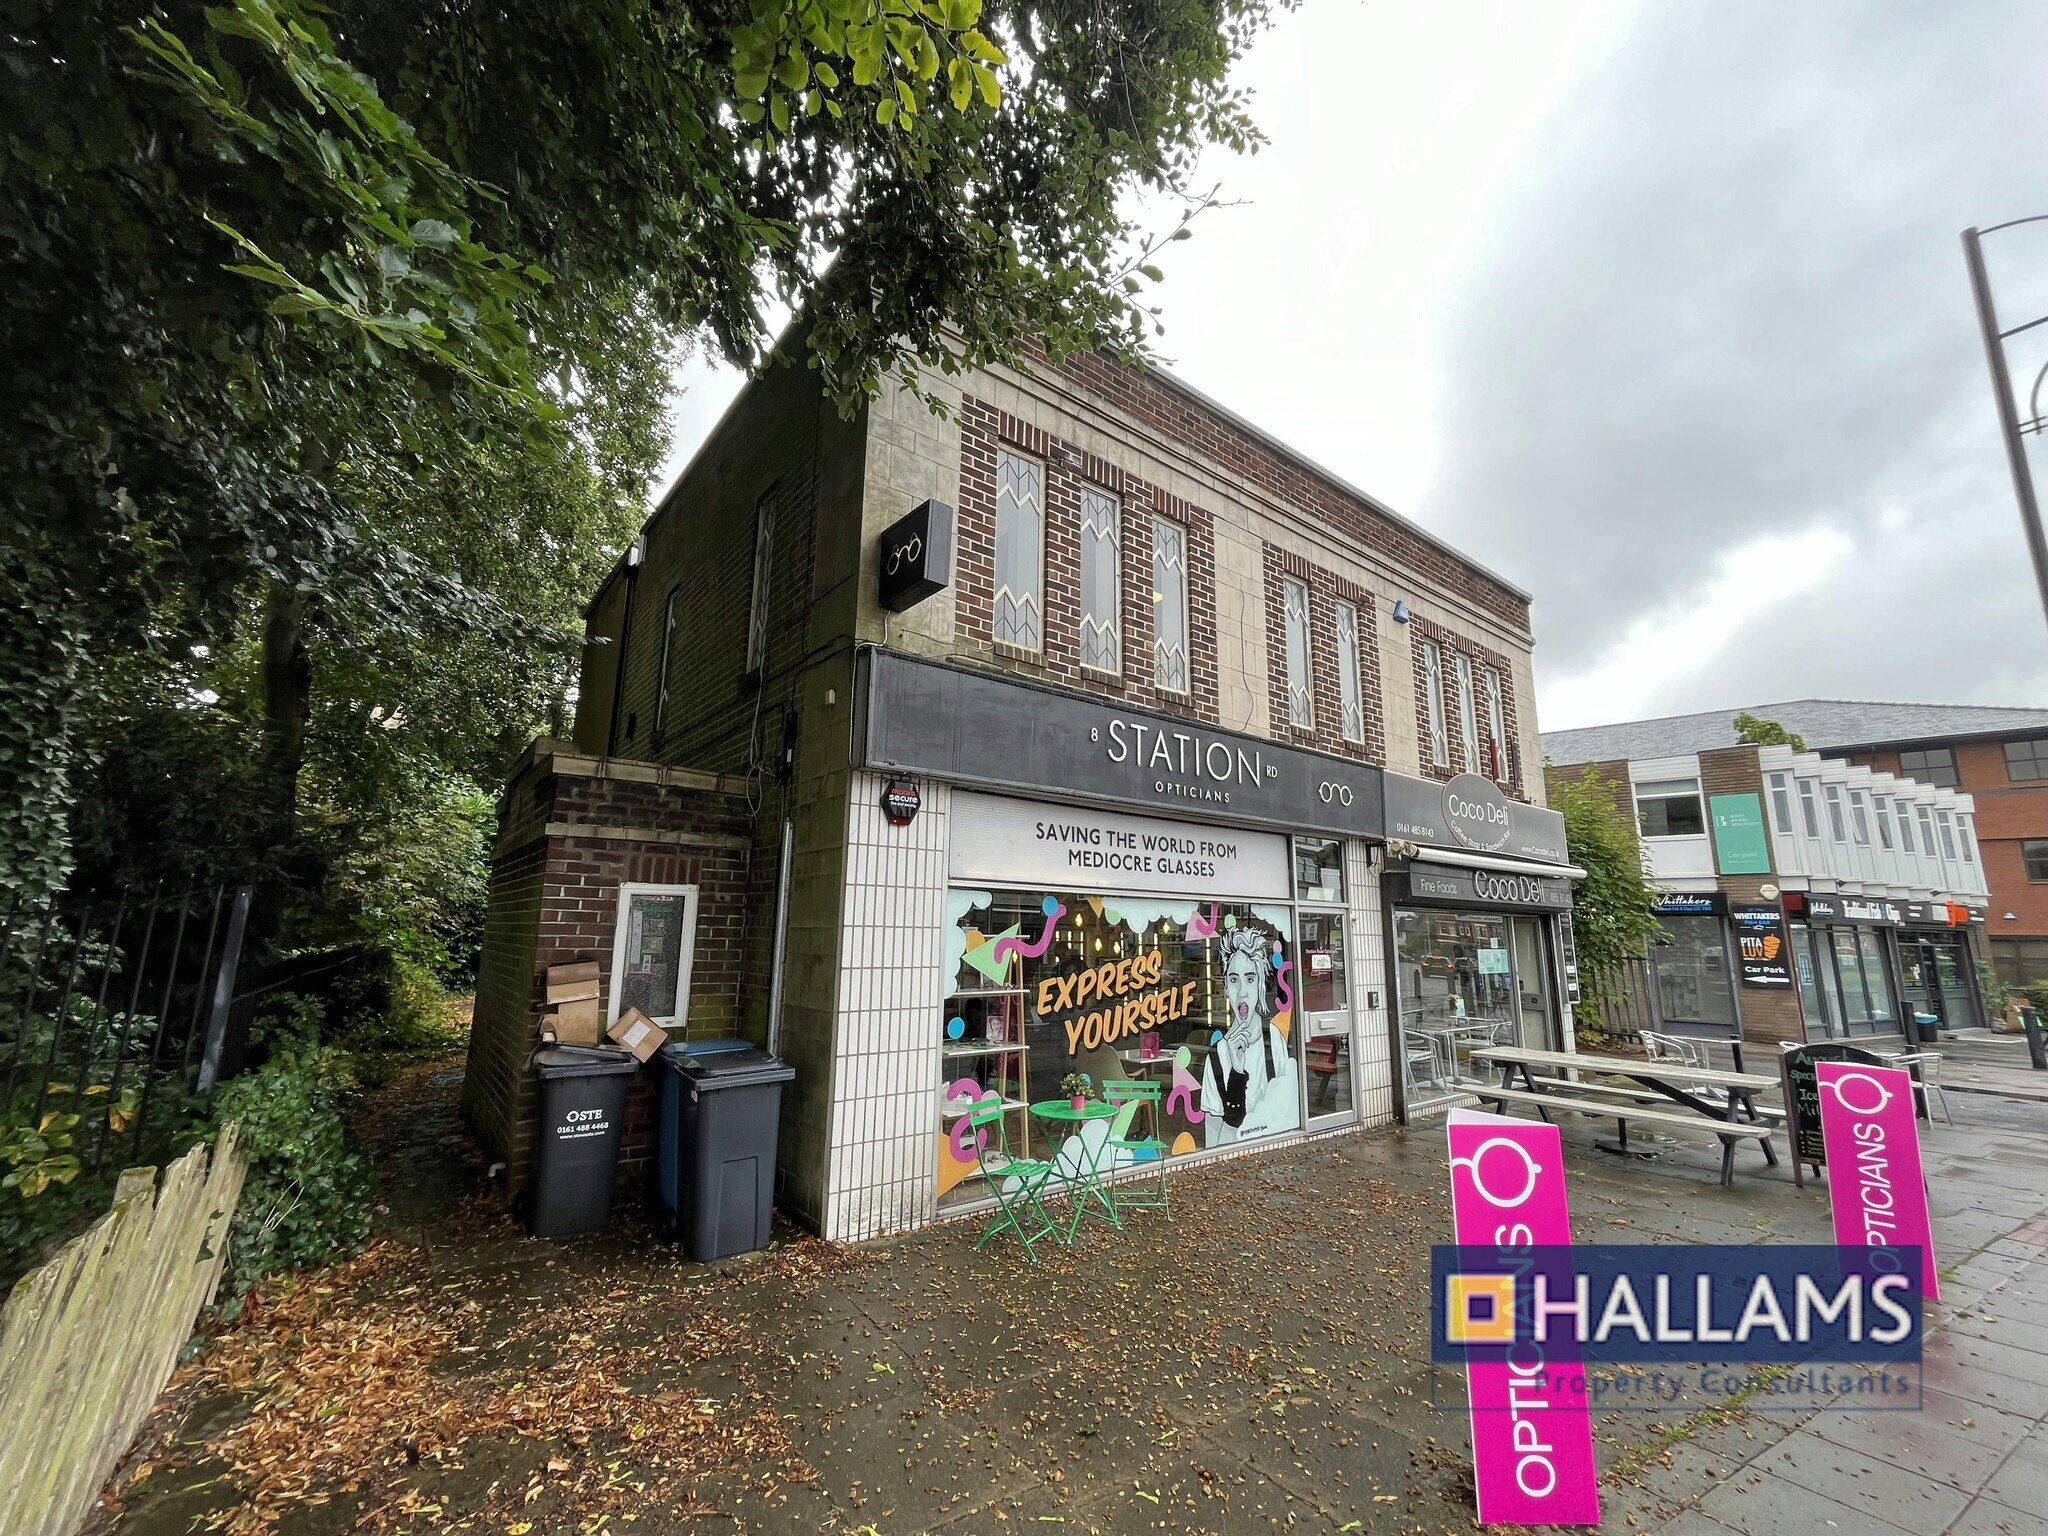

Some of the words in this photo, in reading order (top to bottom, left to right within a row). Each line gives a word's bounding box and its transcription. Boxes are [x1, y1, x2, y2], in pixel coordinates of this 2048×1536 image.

[1091, 727, 1099, 742] 8
[1107, 719, 1261, 788] STATION
[1266, 765, 1278, 778] RD
[889, 794, 918, 804] secure
[1155, 781, 1230, 803] OPTICIANS
[1448, 794, 1485, 821] Coco
[1486, 802, 1509, 826] Deli
[1036, 822, 1101, 845] SAVING
[1106, 830, 1137, 850] THE
[1142, 835, 1195, 855] WORLD
[1200, 841, 1237, 860] FROM
[1396, 822, 1410, 834] 0161
[1411, 825, 1420, 836] 485
[1421, 826, 1434, 838] 8143
[1068, 849, 1152, 873] MEDIOCRE
[1157, 858, 1215, 878] GLASSES
[1420, 878, 1436, 892] Fine
[1437, 880, 1458, 894] Foods
[1474, 870, 1519, 900] Coco
[1519, 876, 1546, 903] Deli
[1733, 912, 1780, 920] WHITTAKERS
[1740, 937, 1762, 948] PITA
[1743, 947, 1763, 957] LUV
[1745, 965, 1761, 973] Car
[1763, 966, 1785, 974] Park
[1036, 950, 1162, 1016] EXPRESS
[1064, 980, 1197, 1056] YOURSELF
[557, 1125, 575, 1134] 0161
[576, 1124, 590, 1132] 488
[591, 1121, 609, 1130] 4468
[1853, 1122, 1901, 1274] OPTICIANS
[1495, 1222, 1556, 1499] OPTICIANS
